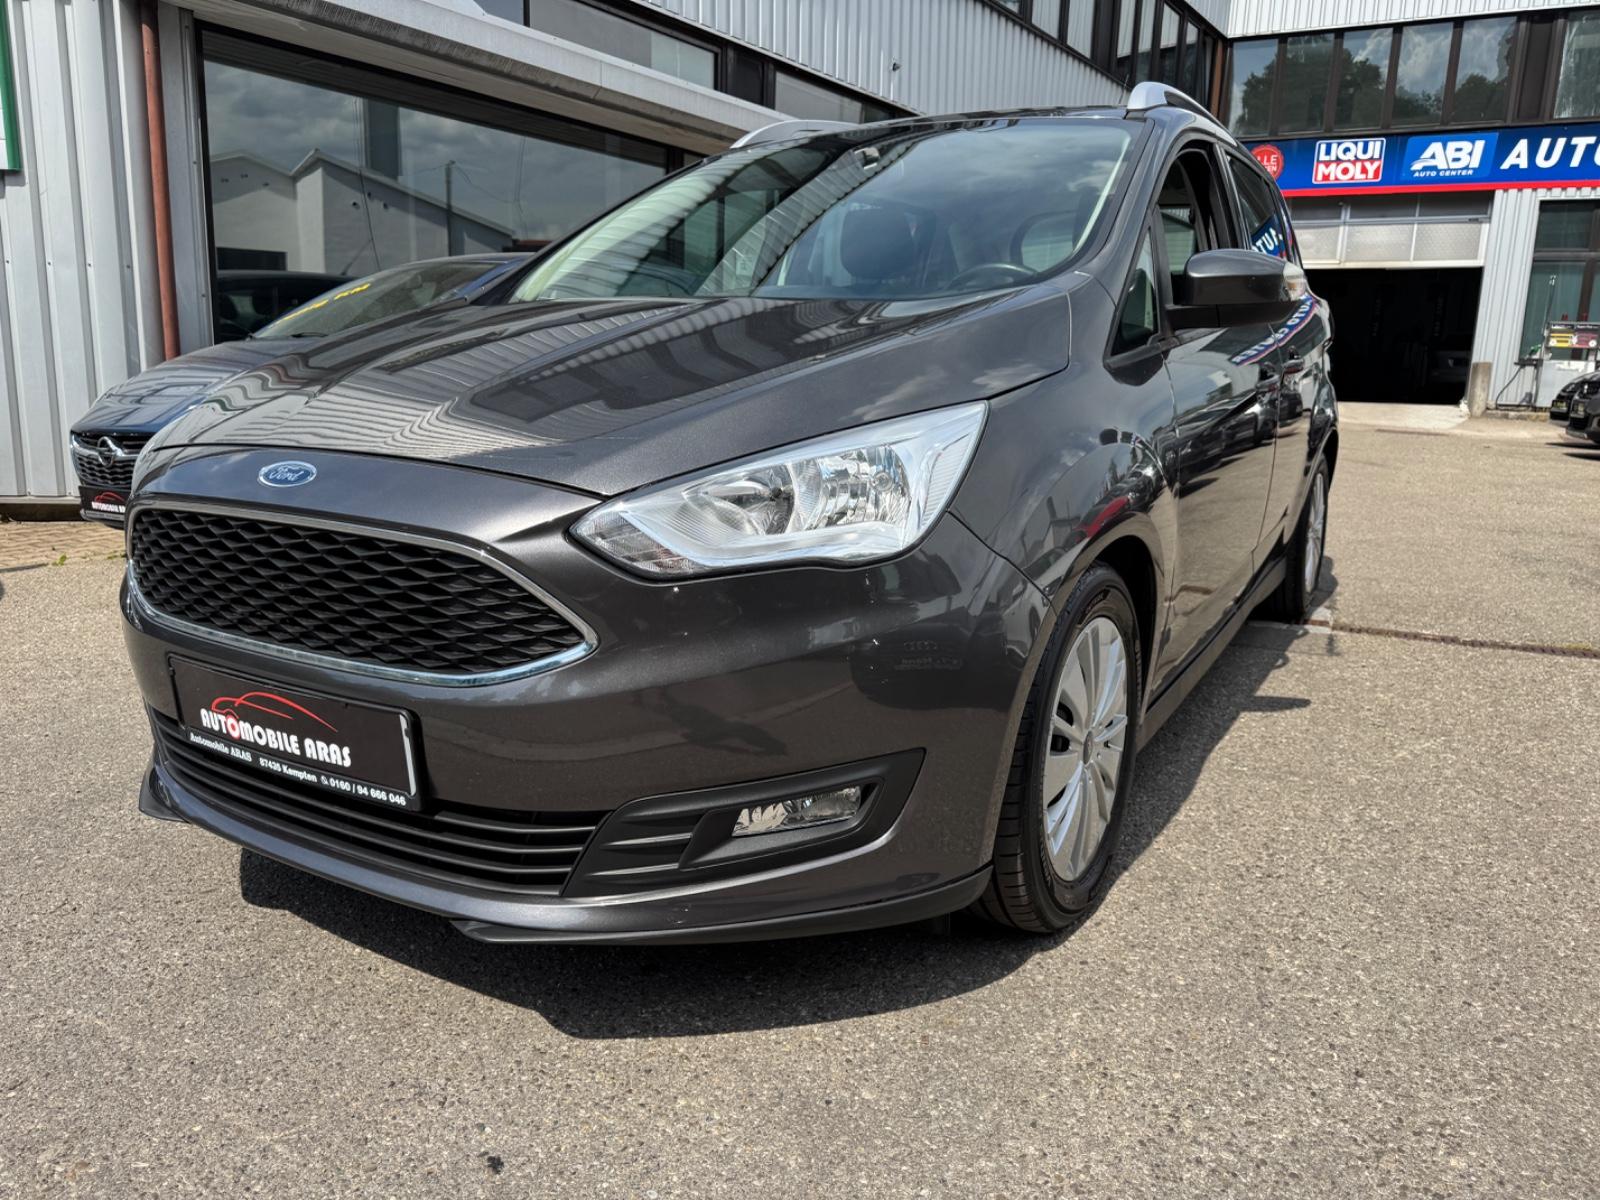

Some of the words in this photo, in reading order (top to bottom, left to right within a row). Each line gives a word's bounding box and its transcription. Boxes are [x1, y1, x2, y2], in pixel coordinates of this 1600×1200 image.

[1318, 141, 1382, 161] LIQUI
[1410, 140, 1486, 171] ABI
[1500, 136, 1600, 170] AUT
[1316, 161, 1381, 181] MOLY
[1439, 169, 1474, 177] CENTER
[200, 708, 301, 756] AUTOMOBILE
[304, 738, 352, 768] ARAS
[190, 732, 229, 754] Automobile
[282, 764, 318, 783] Kempten
[330, 778, 351, 792] 0160
[357, 784, 369, 797] 94
